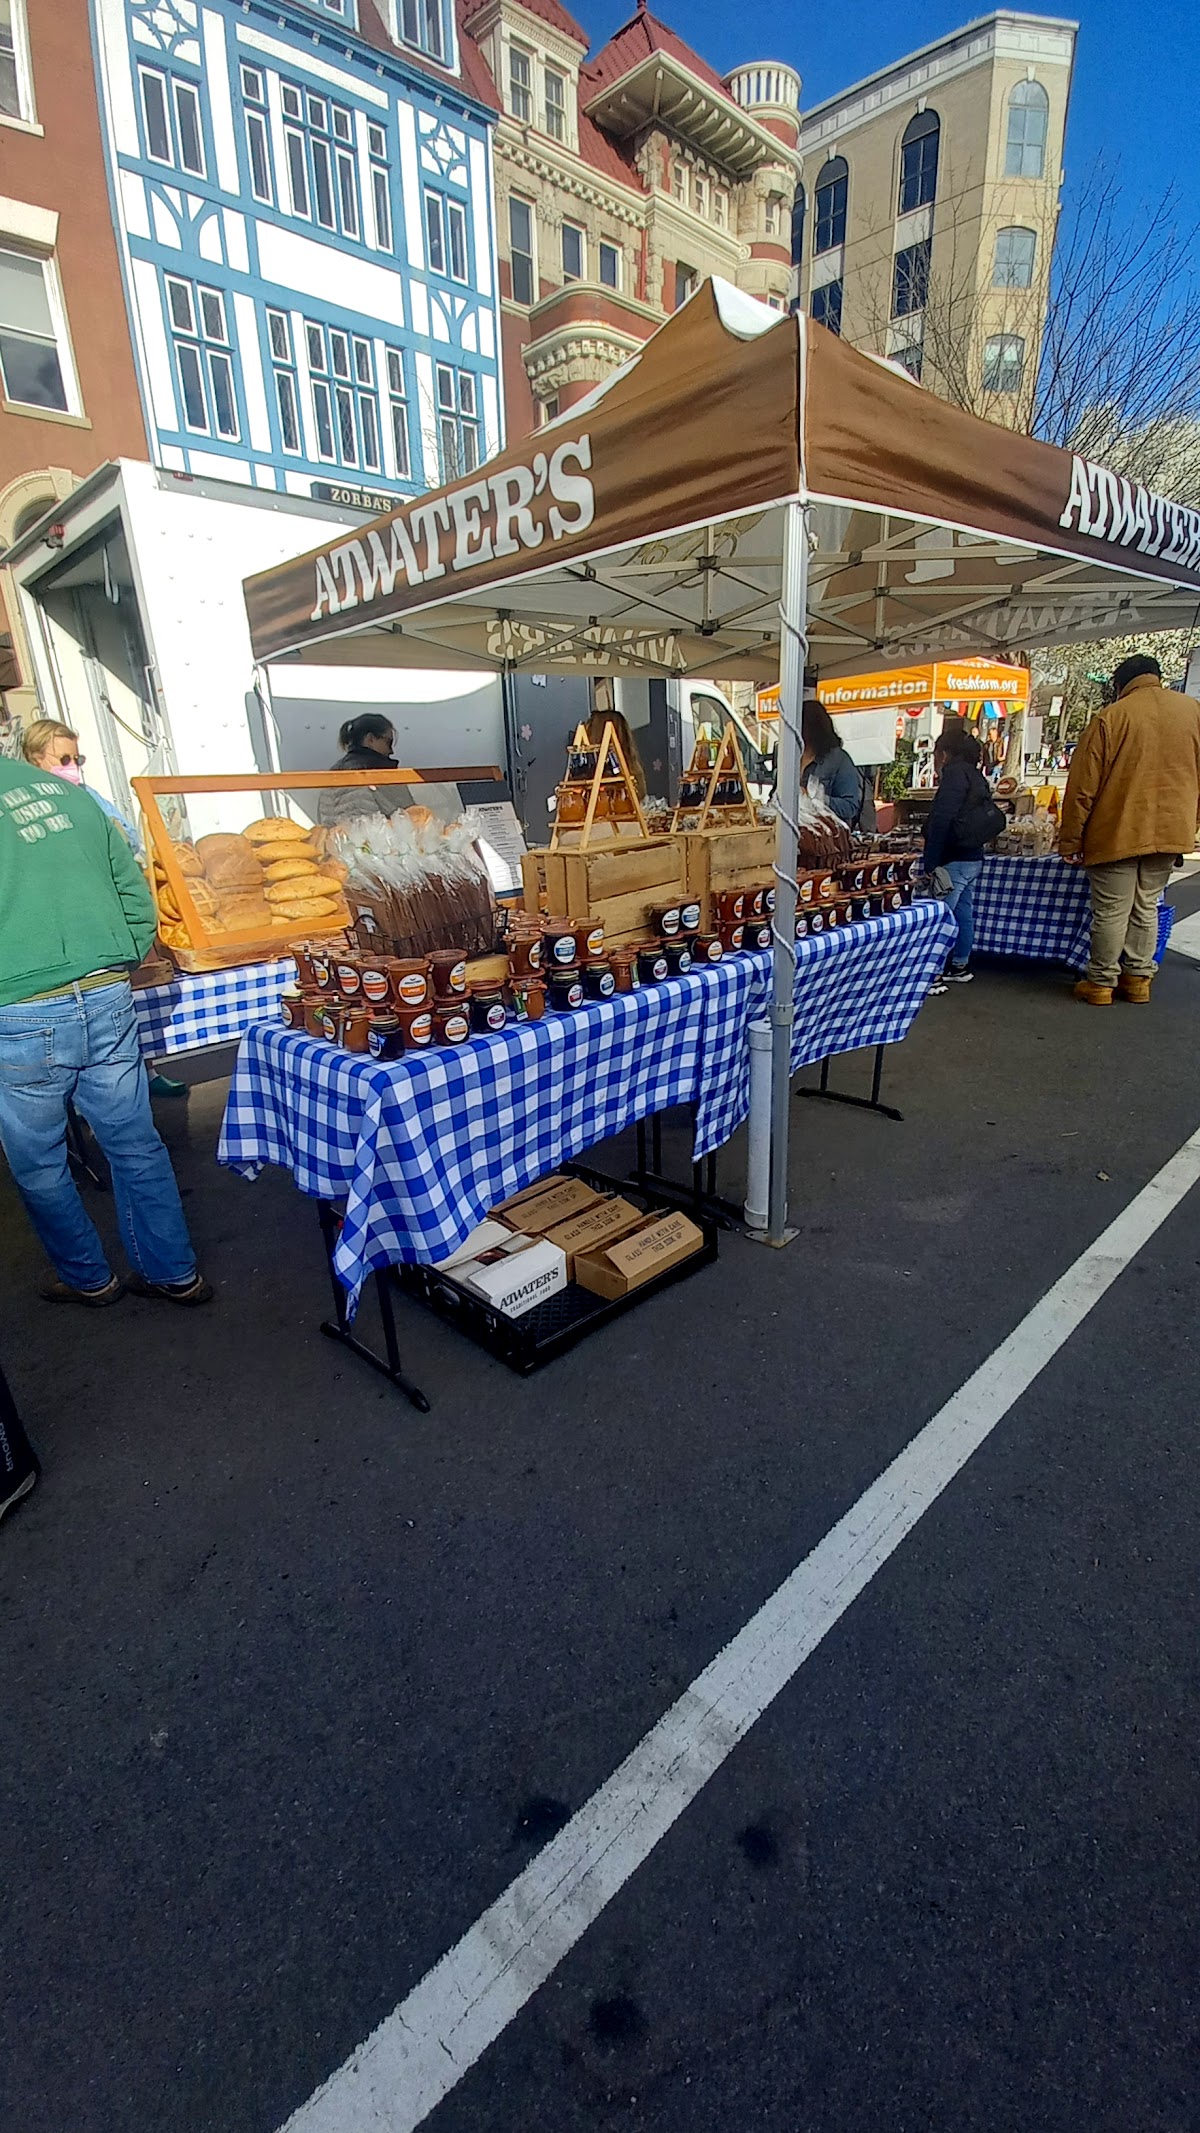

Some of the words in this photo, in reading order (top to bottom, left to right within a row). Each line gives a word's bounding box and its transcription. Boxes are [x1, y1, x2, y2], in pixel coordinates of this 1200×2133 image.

[331, 487, 392, 513] ZORBA'S
[311, 433, 596, 622] ATWATER'S
[819, 679, 928, 705] Information
[946, 673, 1018, 695] freshfarm.org
[29, 782, 69, 796] YOU
[638, 1234, 656, 1247] HANDLE
[655, 1227, 669, 1238] WITH
[668, 1220, 682, 1231] CARE
[651, 1242, 665, 1253] THIS
[663, 1236, 677, 1246] SIDE
[675, 1231, 682, 1239] UP
[625, 1248, 643, 1261] GLASS
[499, 1266, 559, 1310] ATWATER'S
